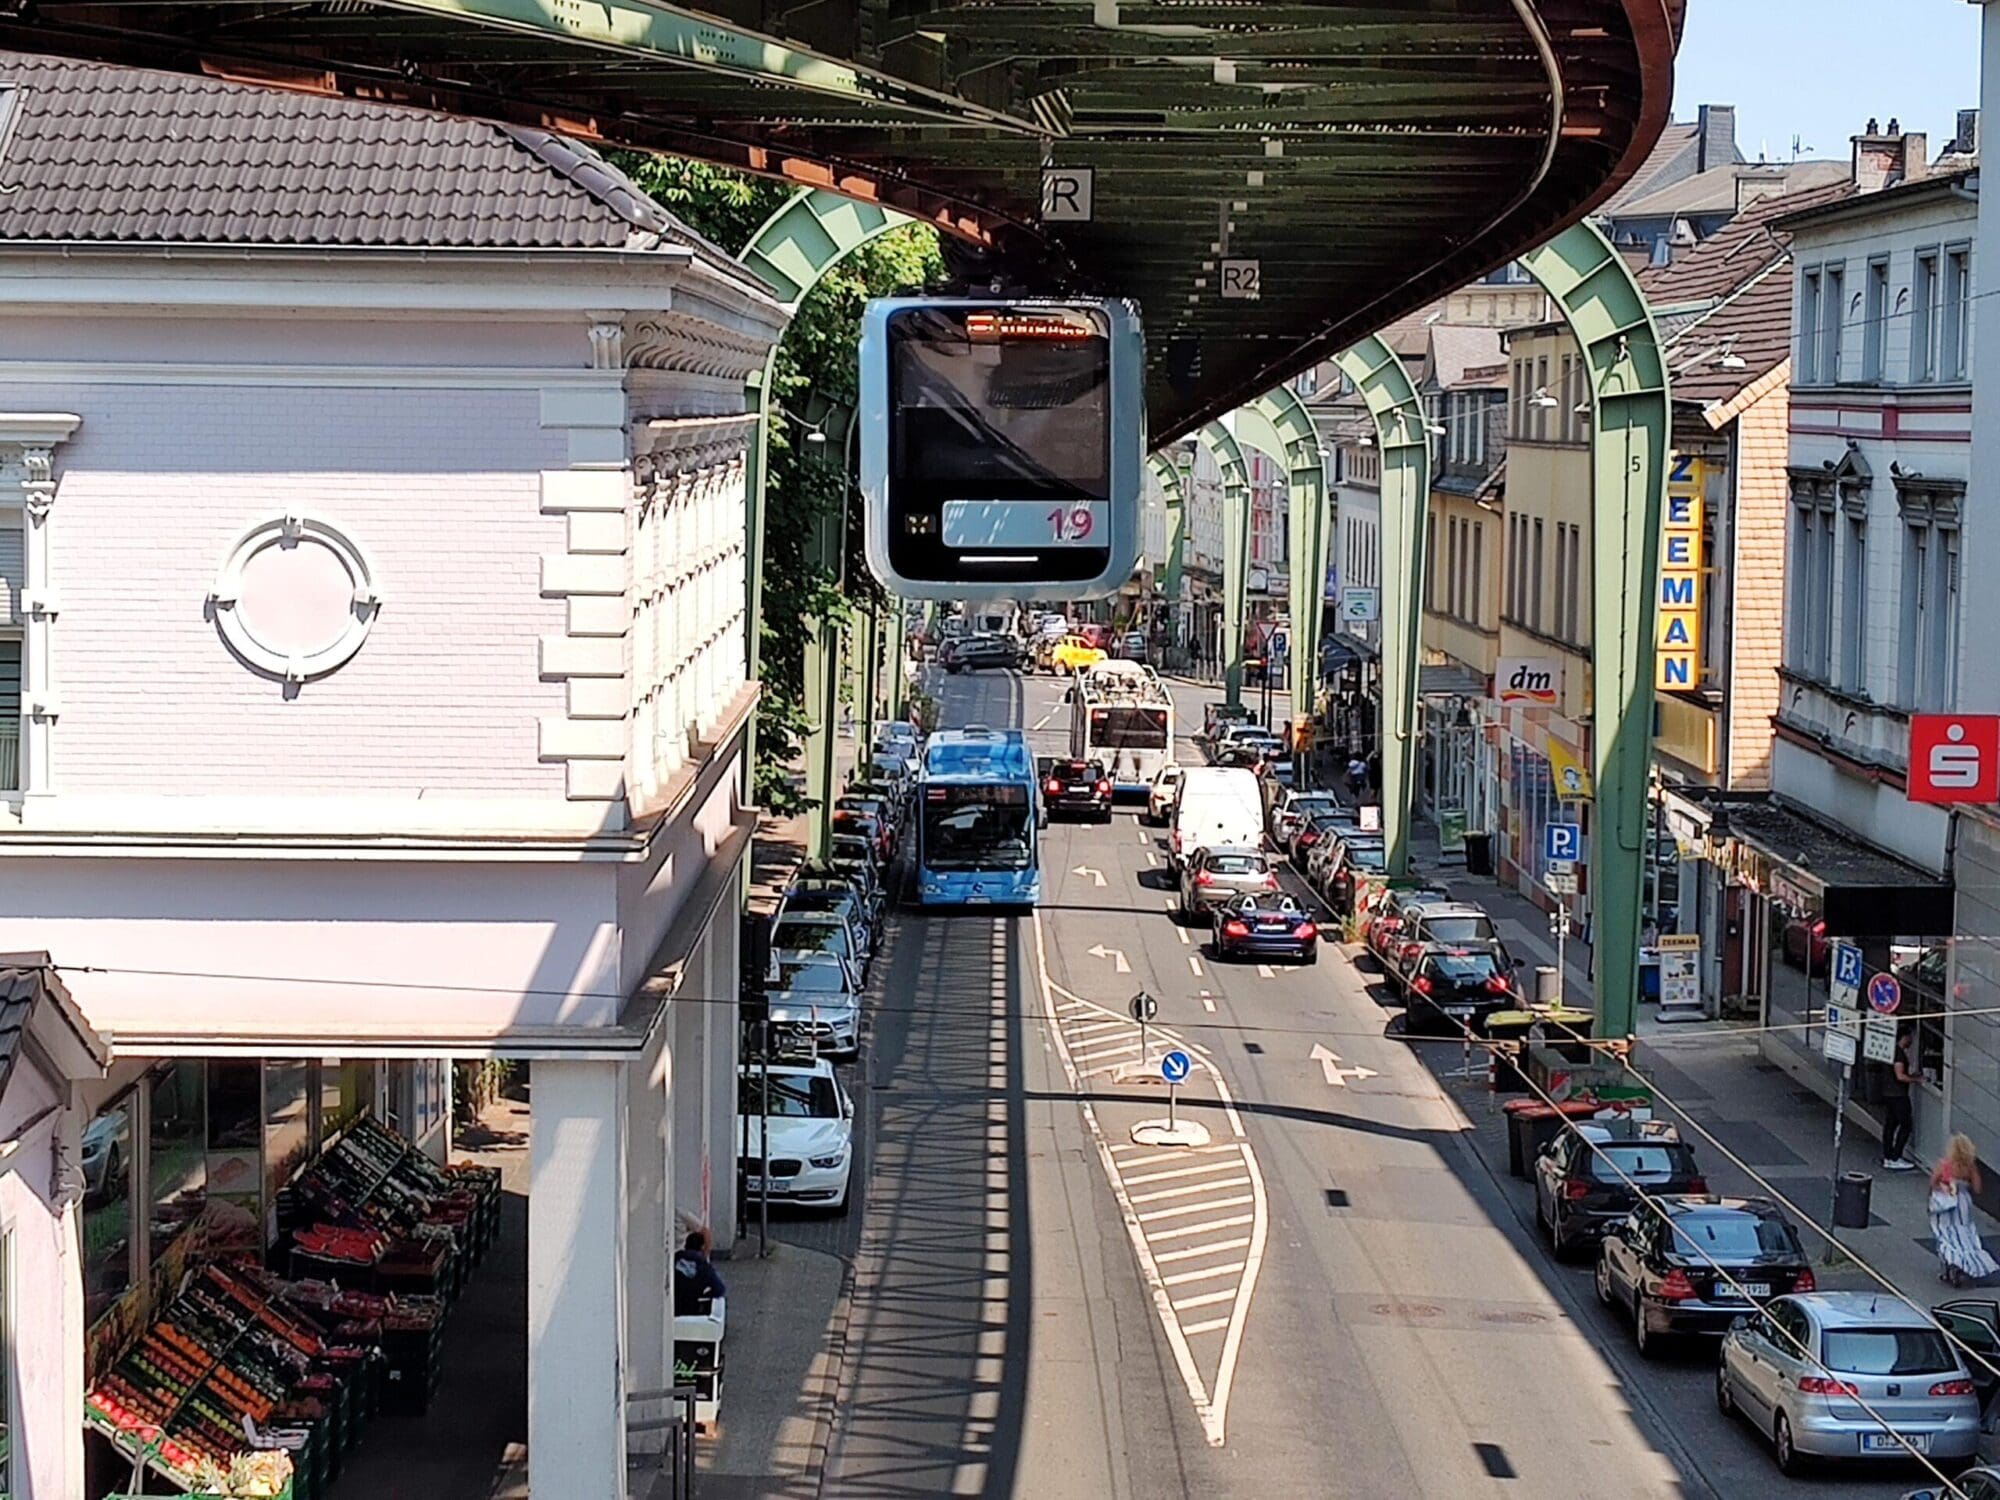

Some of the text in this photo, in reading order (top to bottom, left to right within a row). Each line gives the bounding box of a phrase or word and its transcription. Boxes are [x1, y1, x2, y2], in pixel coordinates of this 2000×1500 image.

[1053, 177, 1079, 212] R
[1224, 267, 1256, 290] R2
[1632, 455, 1641, 472] 5
[1047, 508, 1092, 539] 19
[1663, 455, 1693, 683] ZEEMAN
[1275, 634, 1285, 650] P
[1510, 665, 1551, 689] dm
[1552, 828, 1571, 855] P
